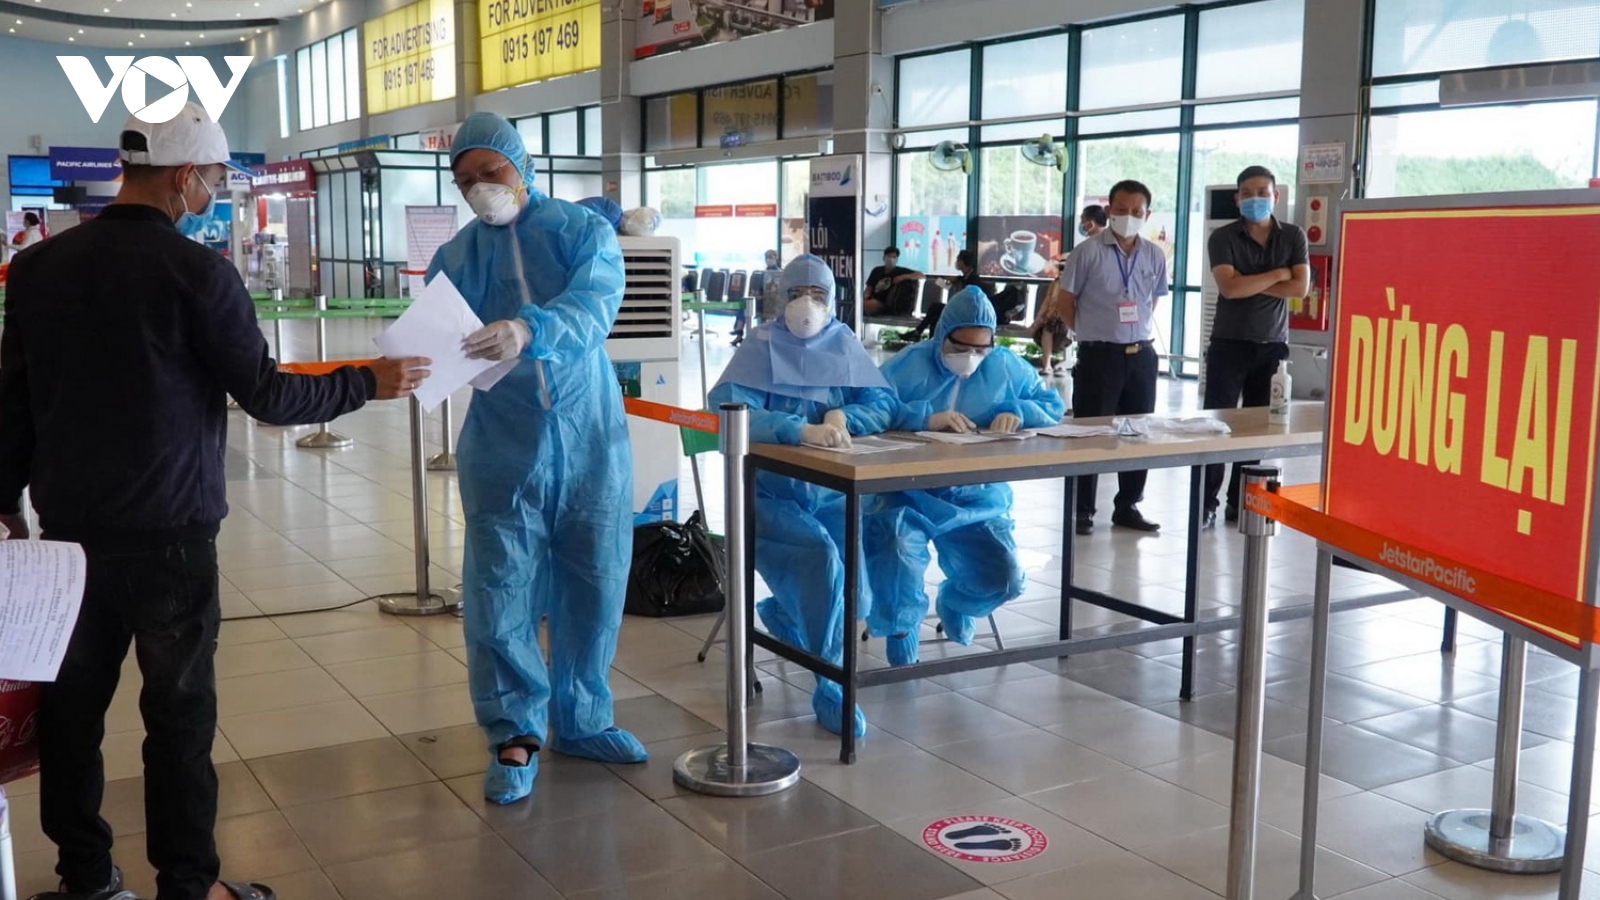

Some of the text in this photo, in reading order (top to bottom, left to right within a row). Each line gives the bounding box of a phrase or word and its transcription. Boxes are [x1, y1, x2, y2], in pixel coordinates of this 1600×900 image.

[488, 1, 511, 29] FOR
[372, 17, 447, 61] FOR ADVERTISING
[502, 20, 579, 64] 0915 197 469
[383, 57, 435, 91] 0915 197 469
[56, 160, 113, 169] PACIFIC AIRLINES
[811, 217, 829, 249] LỐI
[829, 249, 853, 279] TIÊN
[1344, 287, 1577, 535] DỪNG LẠI
[1379, 541, 1477, 594] JetstarPacific
[942, 815, 989, 826] PLEASE
[992, 815, 1024, 828] KEEP
